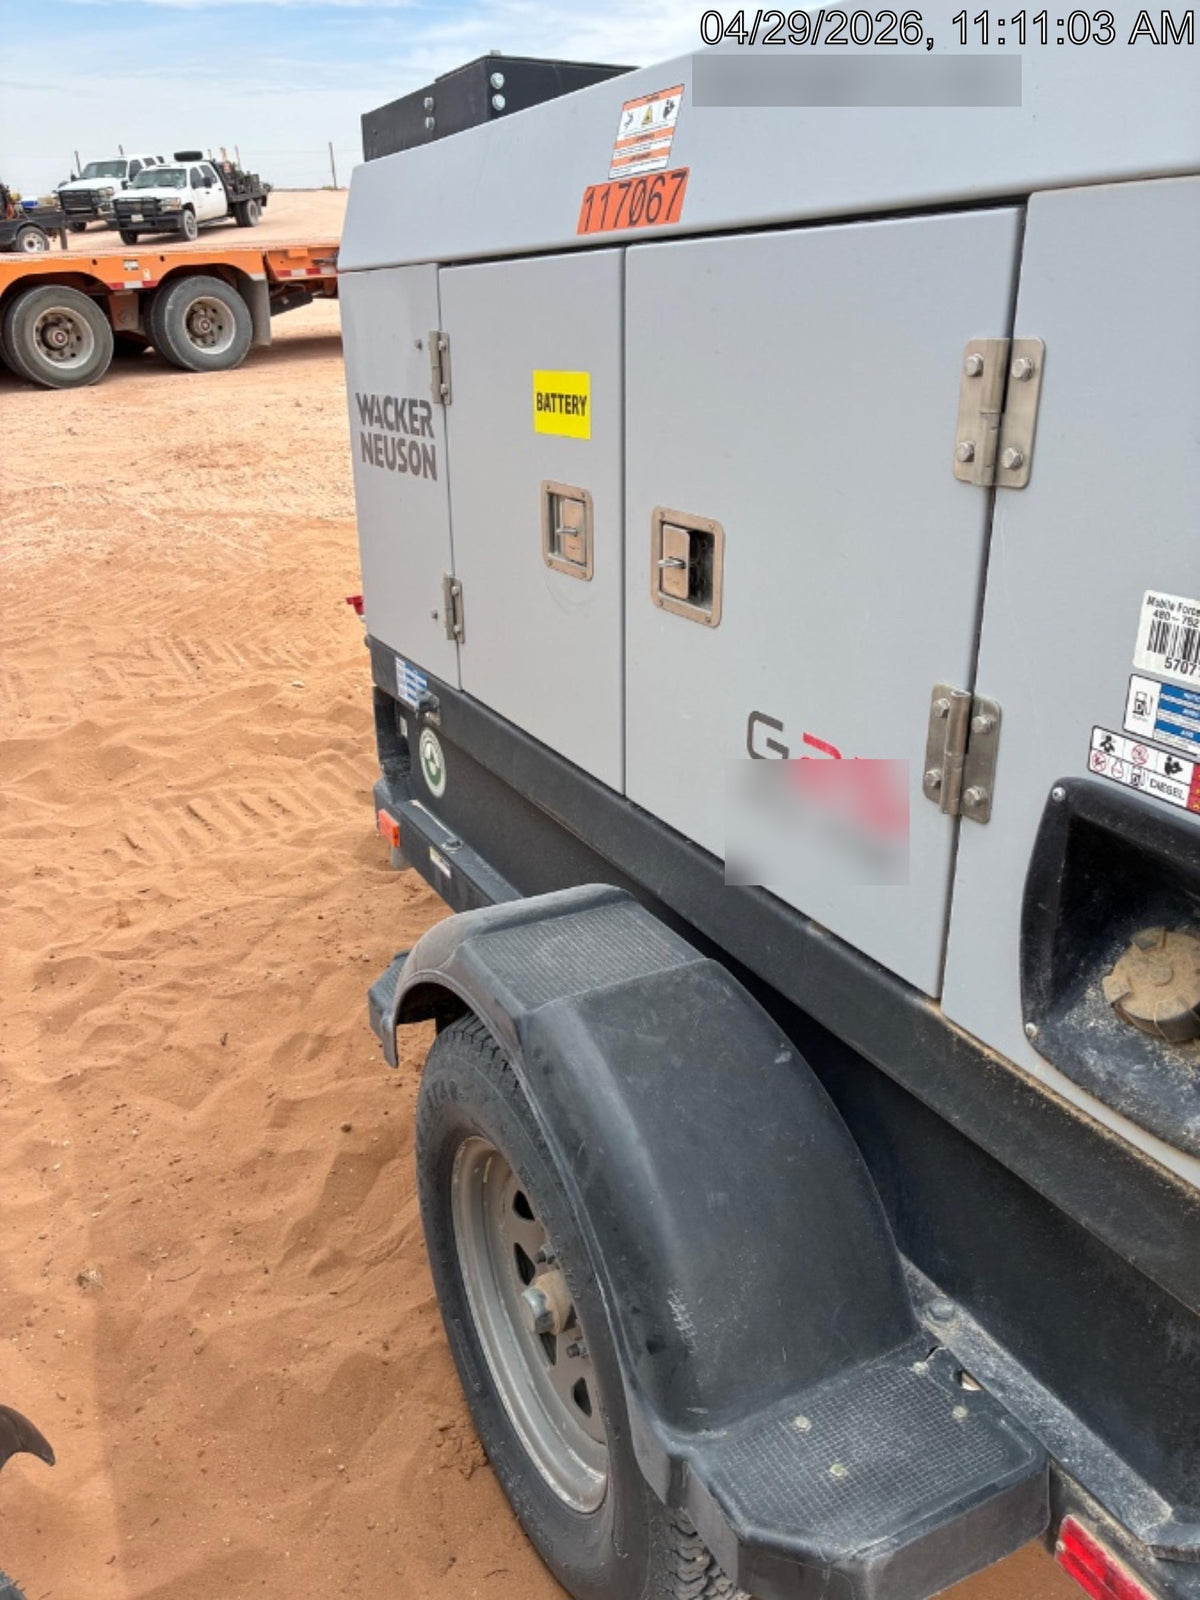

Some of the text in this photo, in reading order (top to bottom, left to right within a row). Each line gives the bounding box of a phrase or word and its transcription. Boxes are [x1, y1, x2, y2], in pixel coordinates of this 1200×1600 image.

[583, 172, 687, 232] 117067
[355, 392, 435, 439] WACKER
[536, 391, 588, 417] BATTERY
[360, 431, 438, 481] NEUSON
[1146, 595, 1175, 611] Mobile
[1164, 656, 1200, 678] 5707
[1149, 778, 1186, 801] DIESEL
